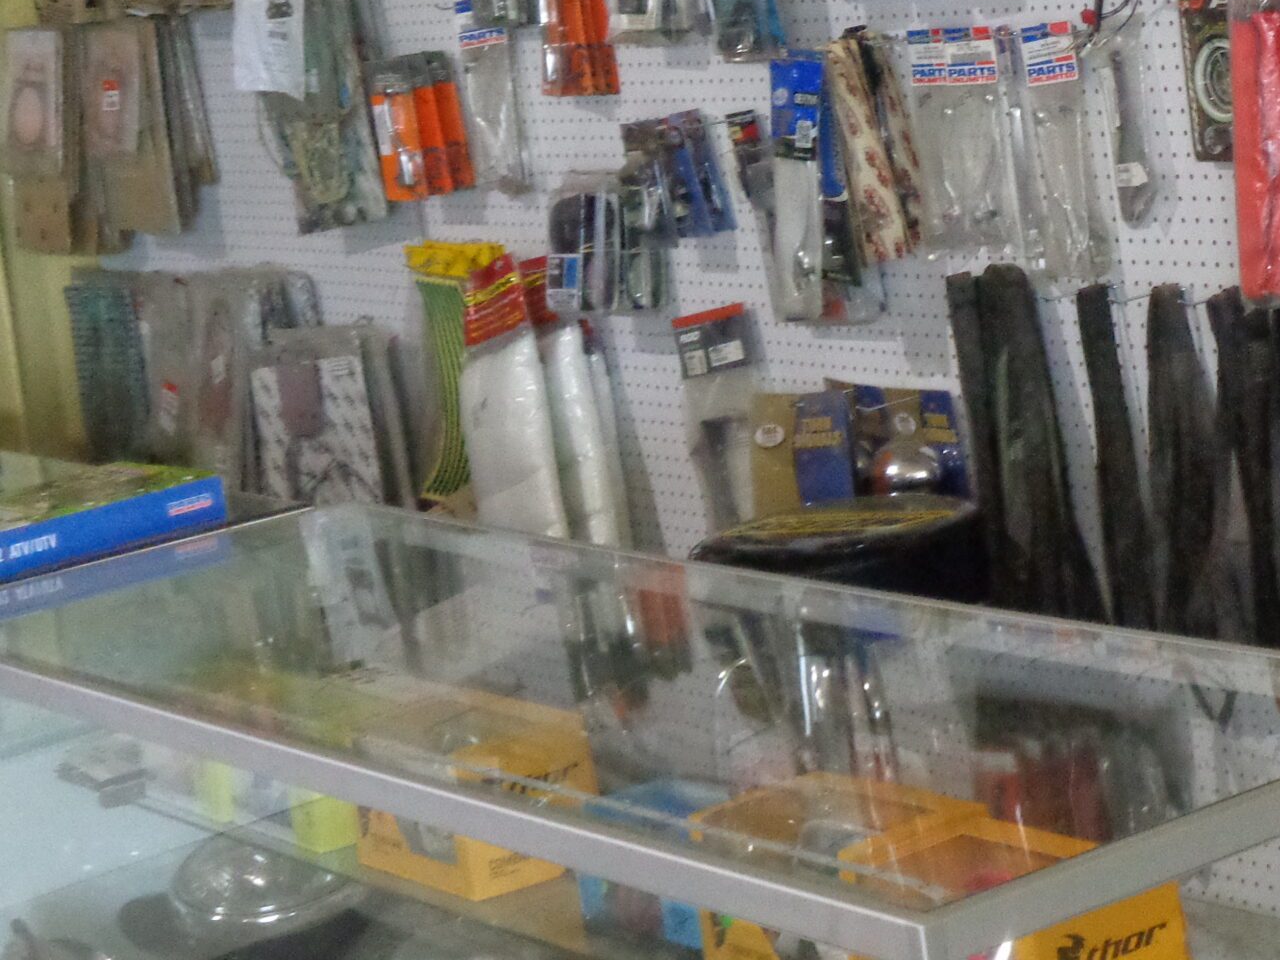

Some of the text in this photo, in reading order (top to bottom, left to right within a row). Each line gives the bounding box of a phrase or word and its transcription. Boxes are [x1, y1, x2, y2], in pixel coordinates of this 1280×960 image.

[912, 67, 945, 78] PART
[948, 66, 996, 77] PARTS
[1028, 62, 1076, 77] PARTS
[1086, 921, 1169, 960] thor
